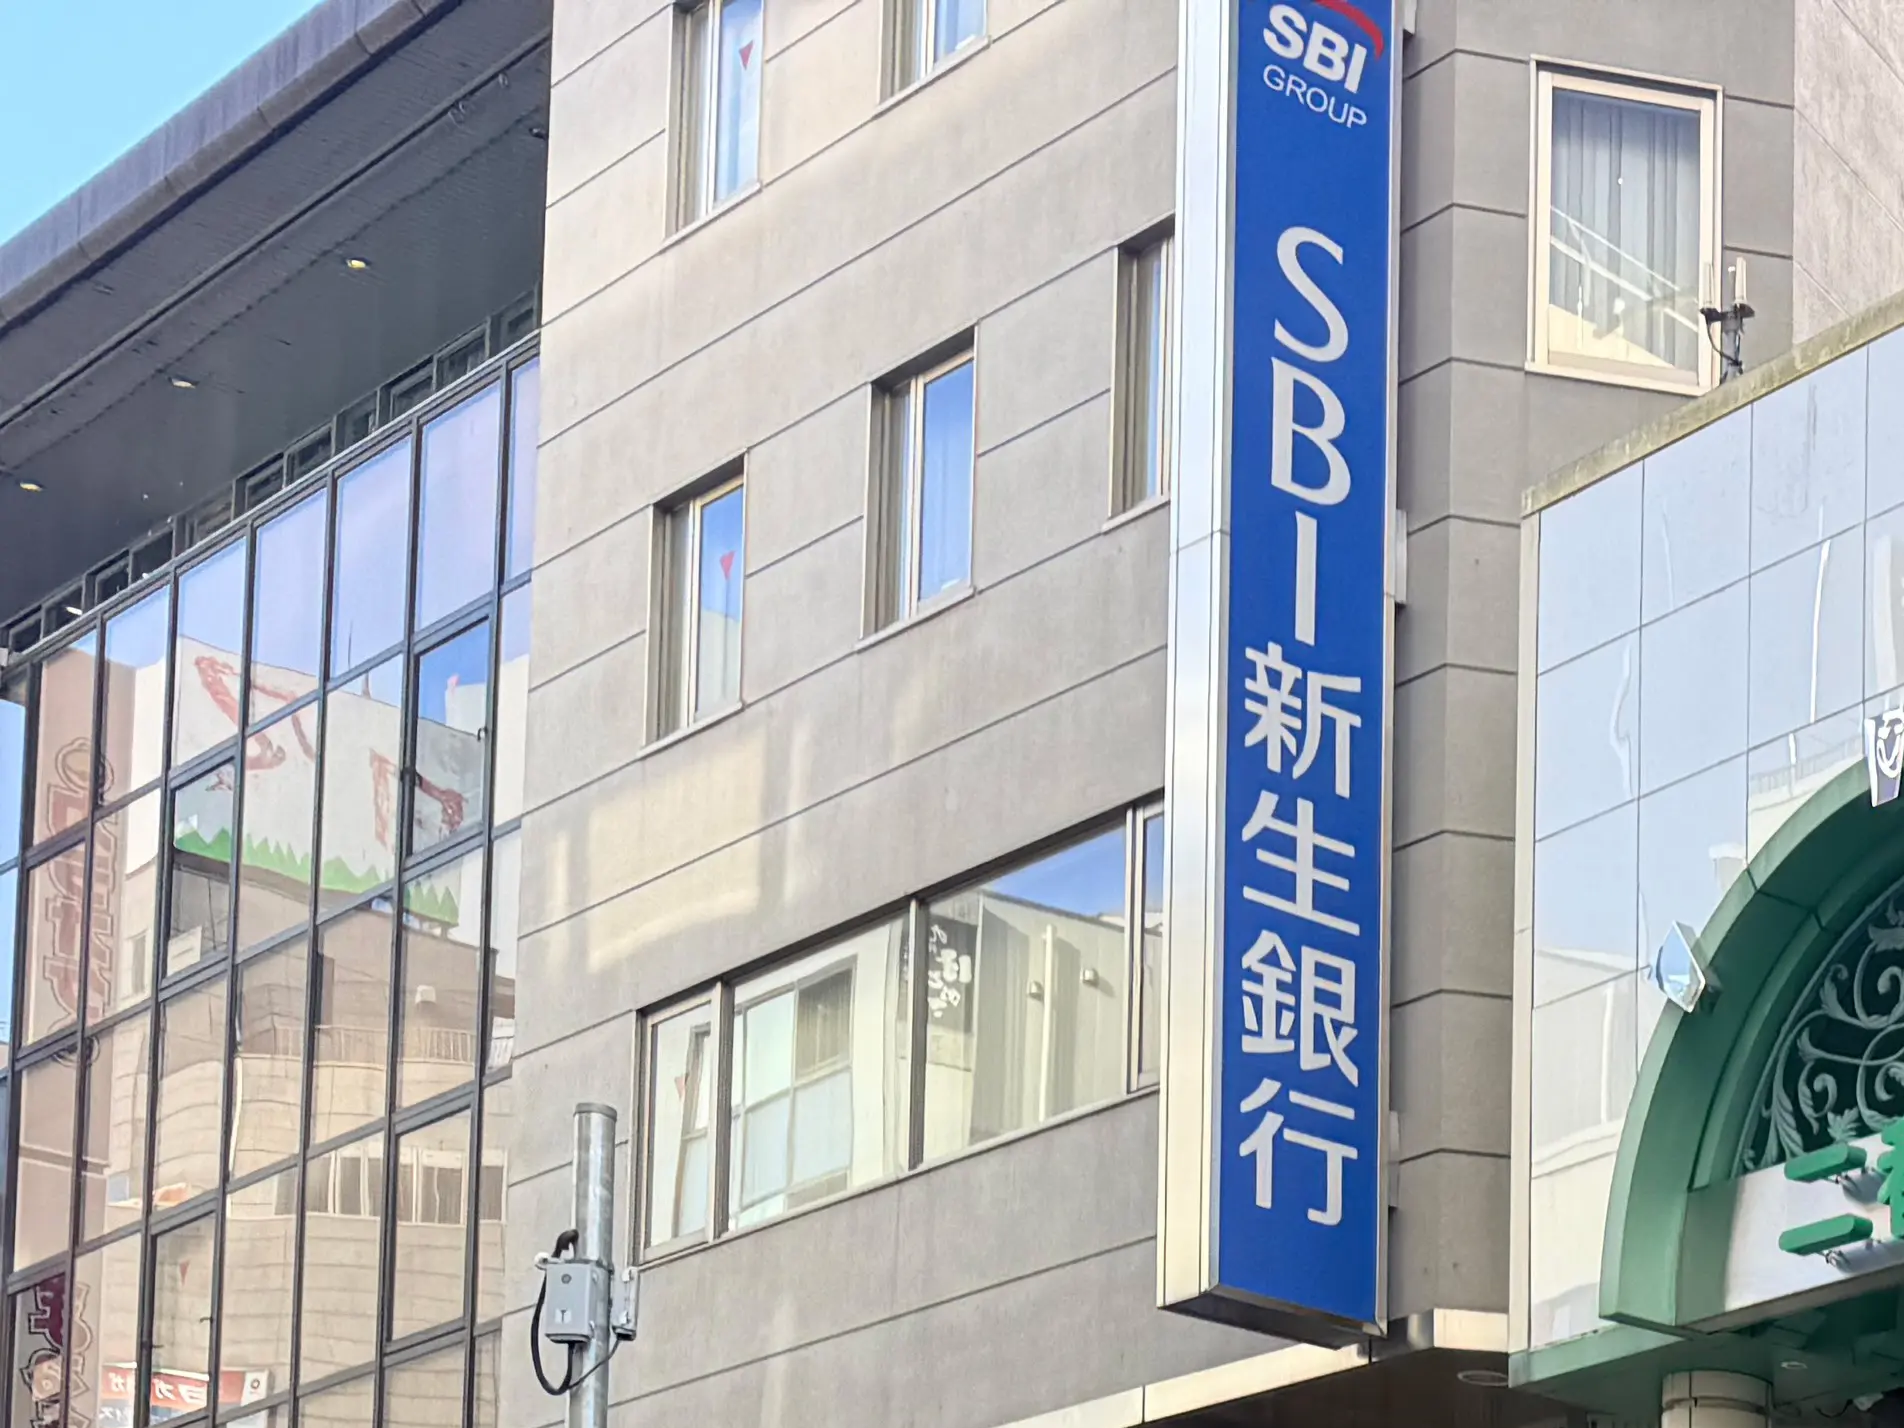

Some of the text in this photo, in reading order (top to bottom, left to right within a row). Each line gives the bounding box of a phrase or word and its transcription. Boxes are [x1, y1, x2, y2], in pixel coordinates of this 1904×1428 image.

[1263, 4, 1368, 94] SBI
[1263, 64, 1367, 128] GROUP
[1240, 225, 1362, 1227] SBI新生銀行
